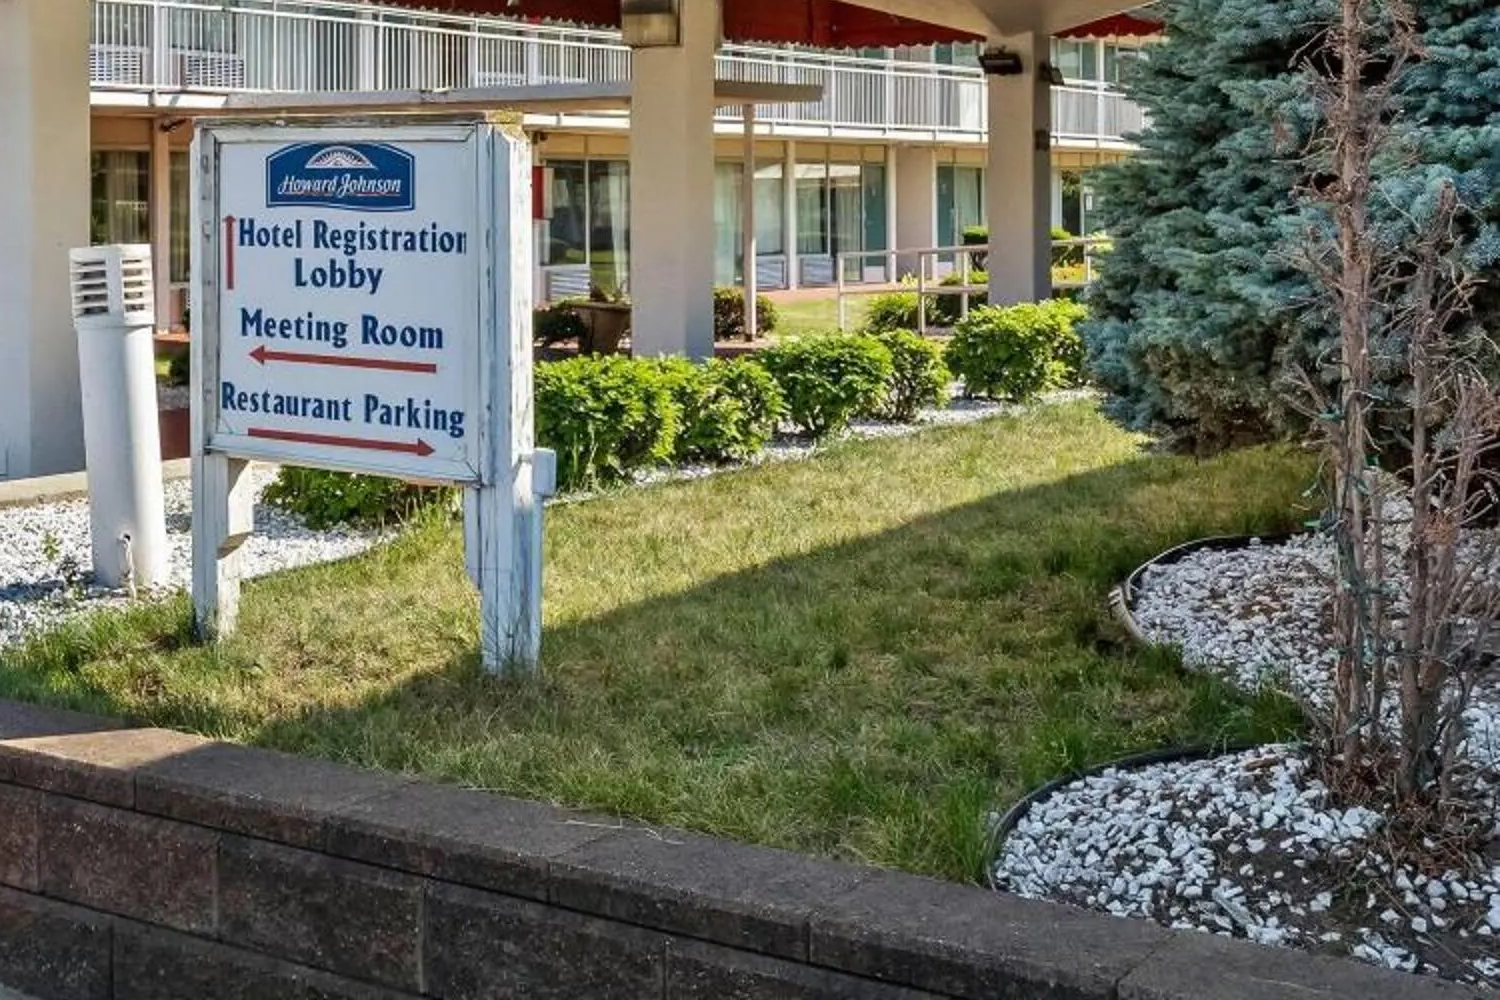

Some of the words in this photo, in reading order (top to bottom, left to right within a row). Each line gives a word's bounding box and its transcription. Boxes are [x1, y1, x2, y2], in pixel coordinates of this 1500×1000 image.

[277, 174, 338, 195] Howard
[336, 173, 402, 197] Johnson
[238, 217, 302, 249] Hotel
[294, 257, 384, 295] Lobby
[240, 307, 349, 348] Meeting
[361, 314, 444, 350] Room
[221, 381, 353, 422] Restaurant
[364, 394, 465, 438] Parking
